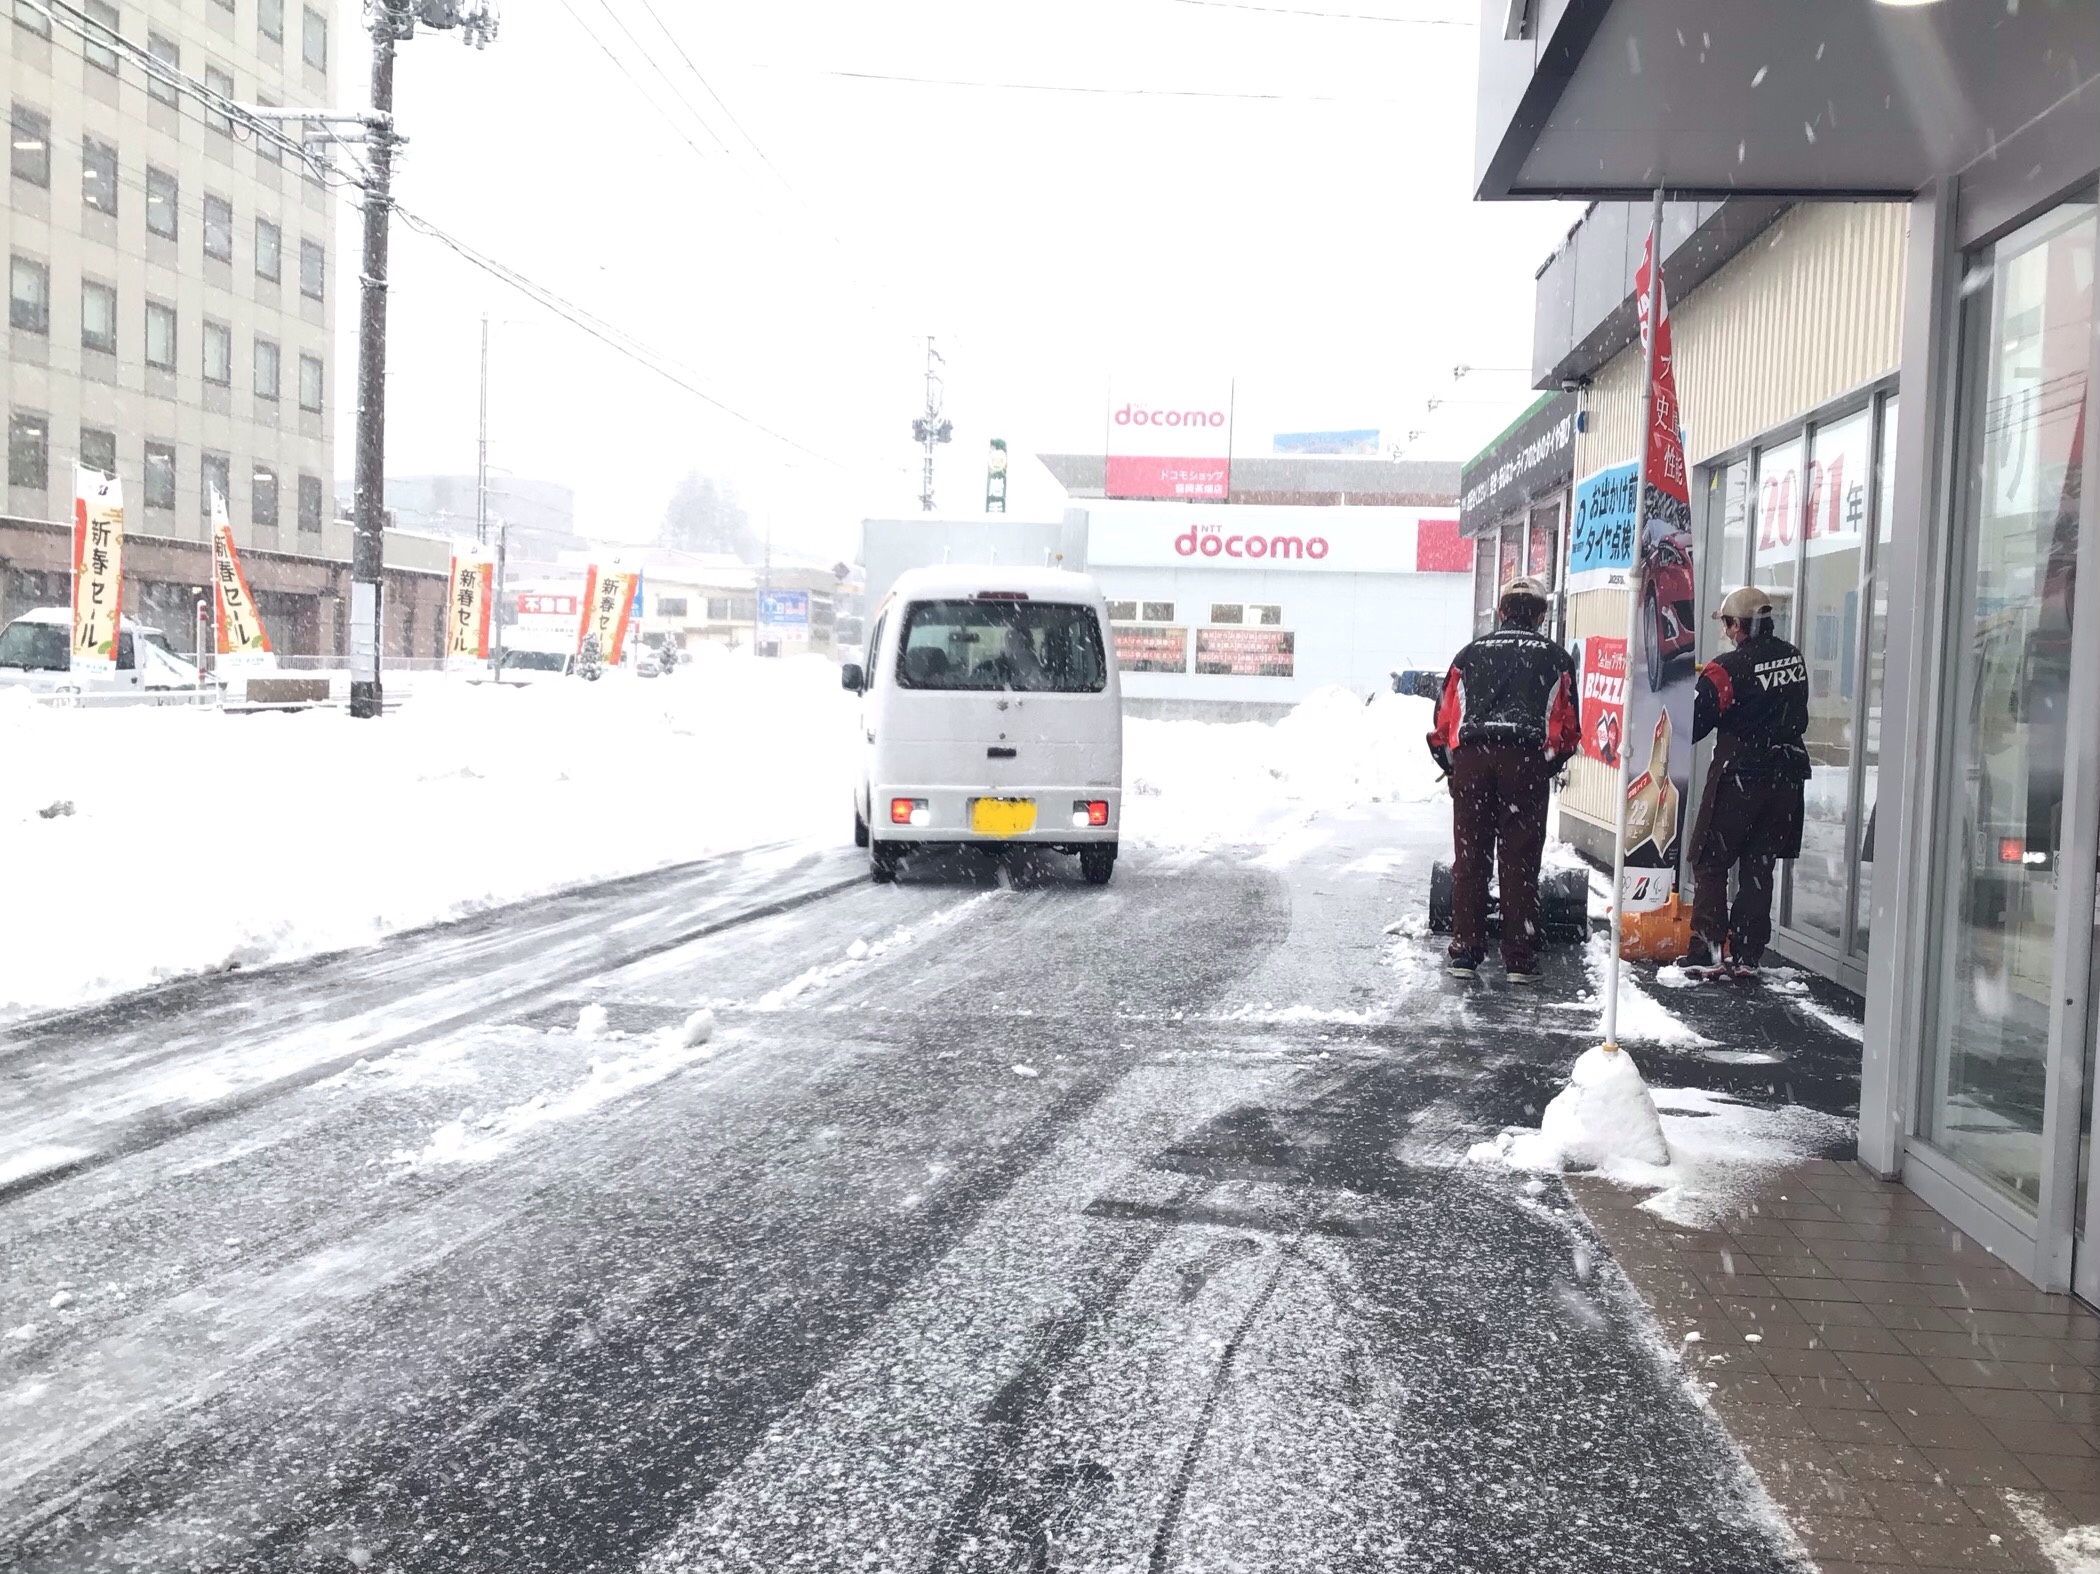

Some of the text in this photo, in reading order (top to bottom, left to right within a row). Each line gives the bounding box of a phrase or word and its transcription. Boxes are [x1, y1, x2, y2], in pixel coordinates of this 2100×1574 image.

[1115, 403, 1225, 427] docomo
[1161, 470, 1225, 481] ドコモショップ
[1589, 471, 1639, 520] お出かけ前
[1759, 451, 1864, 551] 2021年
[1175, 525, 1329, 560] docomo
[1201, 524, 1223, 533] NTT
[1585, 519, 1636, 563] タイヤ点検
[81, 518, 112, 649] 新春セール
[214, 534, 251, 646] 新春セール
[454, 569, 477, 652] 新春セール
[1518, 638, 1550, 650] VRX
[1756, 663, 1806, 691] VRX2
